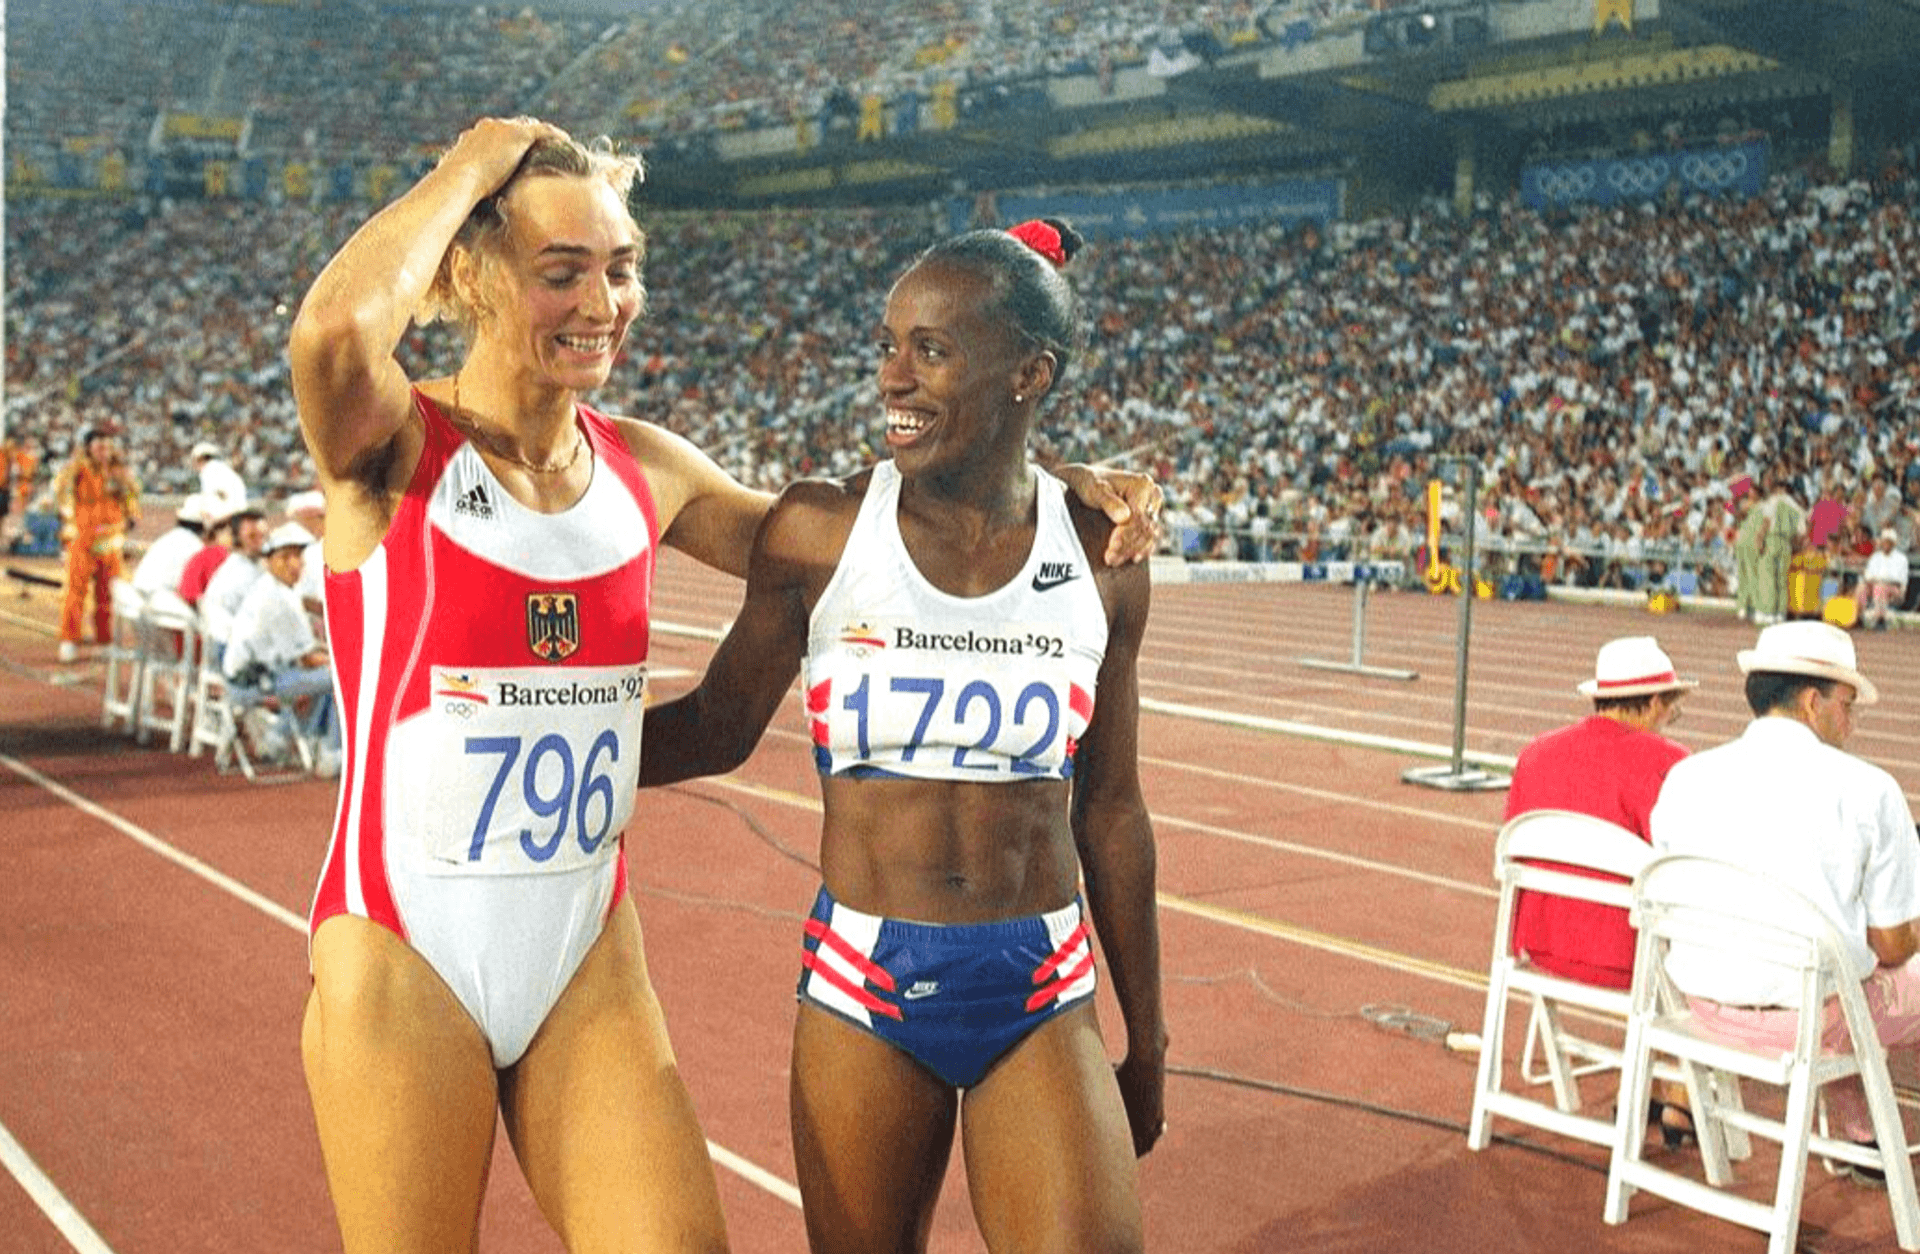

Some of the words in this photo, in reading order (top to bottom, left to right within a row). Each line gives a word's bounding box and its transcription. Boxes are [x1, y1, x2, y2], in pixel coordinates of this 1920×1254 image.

[1039, 562, 1073, 579] NIKE
[843, 673, 1060, 773] 1722
[464, 729, 619, 862] 796
